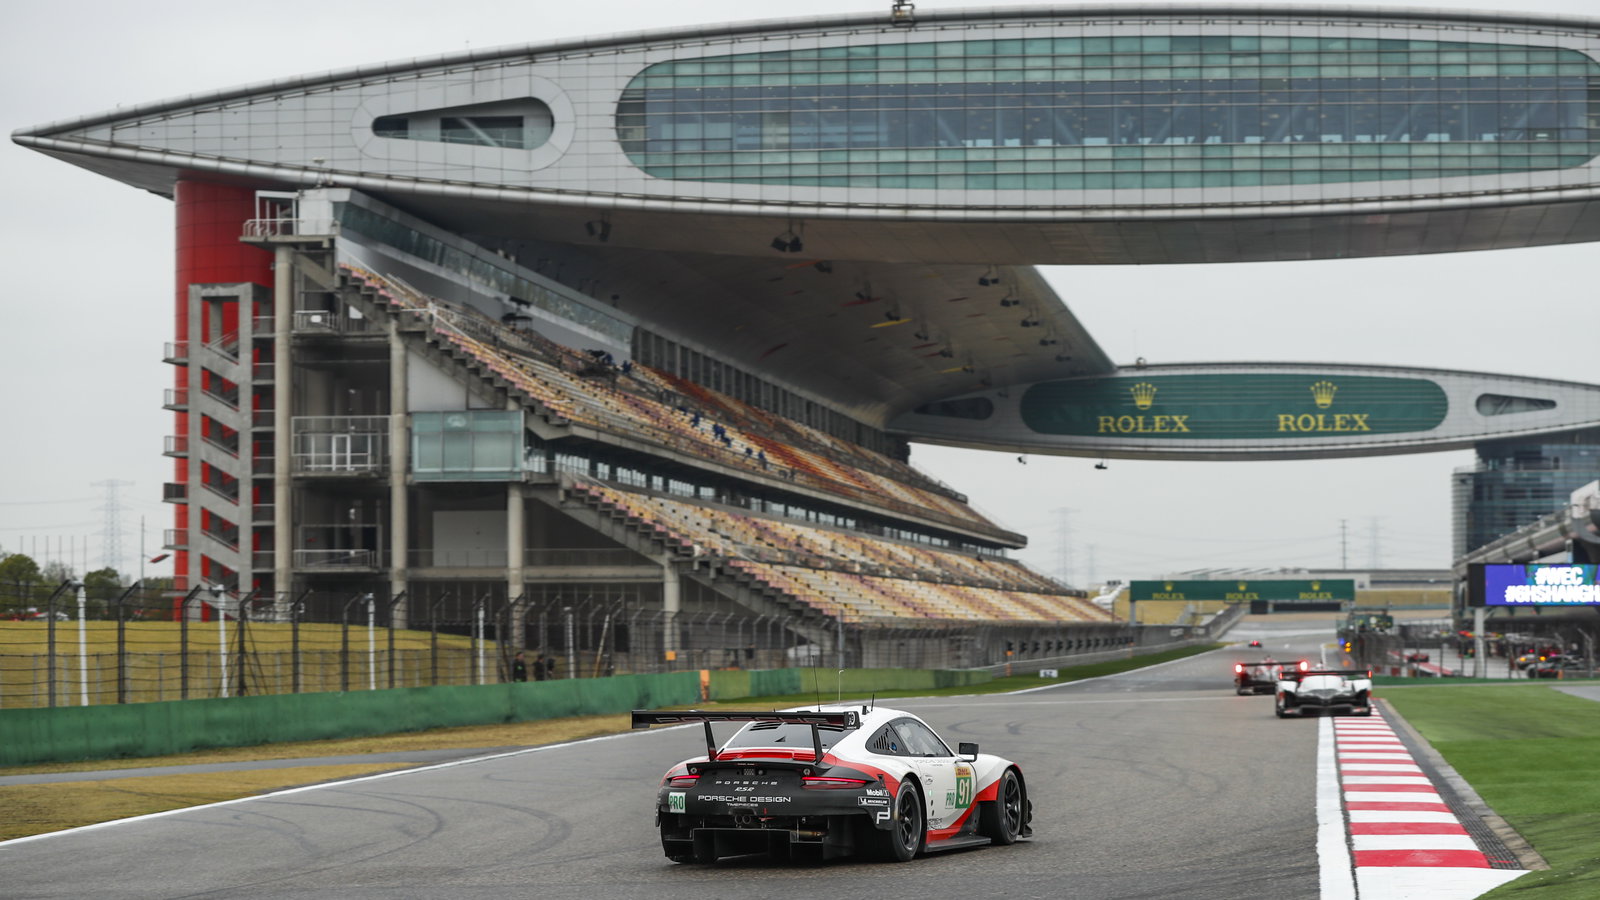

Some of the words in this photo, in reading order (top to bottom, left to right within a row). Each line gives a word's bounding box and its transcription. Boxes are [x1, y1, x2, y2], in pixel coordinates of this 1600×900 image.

[1098, 415, 1191, 433] ROLEX
[1277, 413, 1371, 431] ROLEX
[1535, 567, 1584, 585] #WEC
[1226, 592, 1259, 600] ROLEX
[945, 792, 955, 806] PRO
[958, 778, 971, 805] 91
[669, 795, 684, 810] PRO
